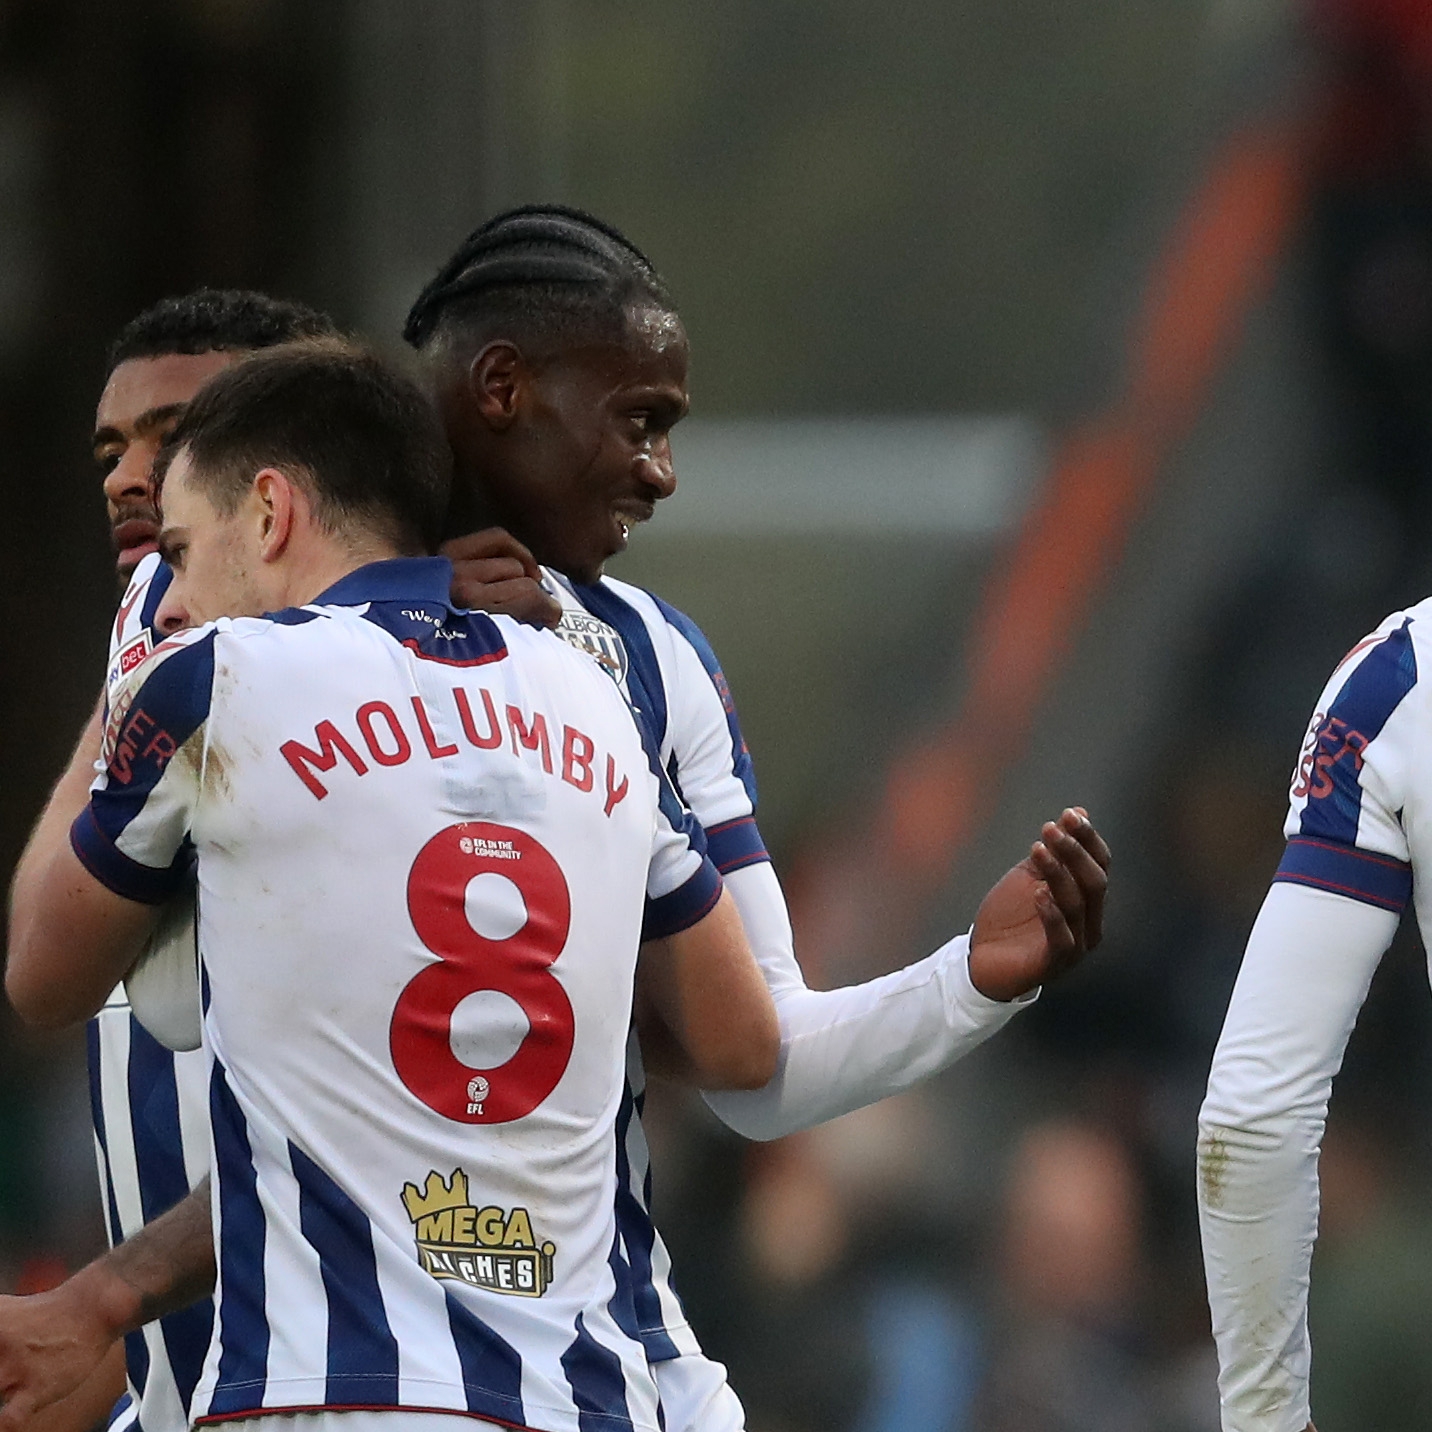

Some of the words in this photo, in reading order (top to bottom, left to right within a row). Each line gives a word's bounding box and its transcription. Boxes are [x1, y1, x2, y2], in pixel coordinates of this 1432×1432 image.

[122, 645, 147, 669] bet
[279, 686, 629, 817] MOLUMBY
[474, 847, 522, 860] COMMUNITY
[389, 821, 576, 1125] 8
[466, 1102, 484, 1115] EFL
[417, 1207, 536, 1247] MEGA
